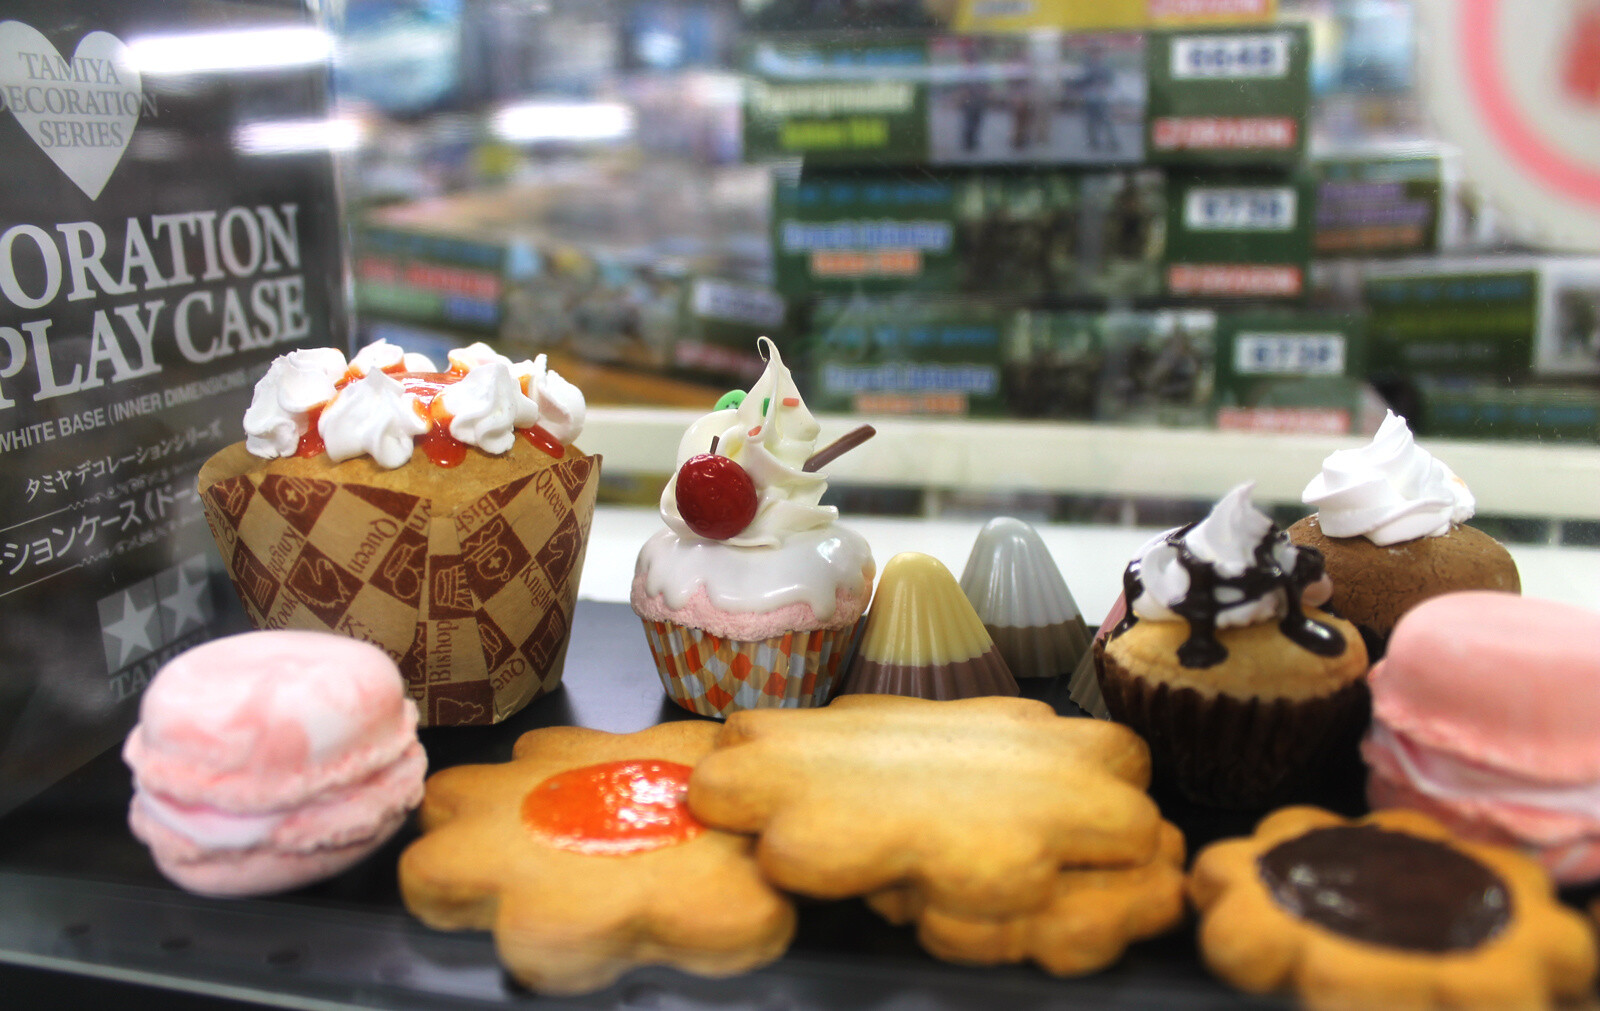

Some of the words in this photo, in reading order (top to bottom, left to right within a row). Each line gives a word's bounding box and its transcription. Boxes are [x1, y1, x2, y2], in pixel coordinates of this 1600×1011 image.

[18, 51, 121, 85] TAMIYA
[0, 84, 159, 119] ECORATION
[38, 119, 124, 148] SERIES
[0, 203, 300, 310] ORATION
[173, 276, 310, 364] CASE
[58, 408, 105, 437] BASE
[108, 391, 163, 425] (INNER
[535, 468, 567, 522] Queen
[346, 518, 399, 574] Queen
[429, 620, 459, 684] Bishop
